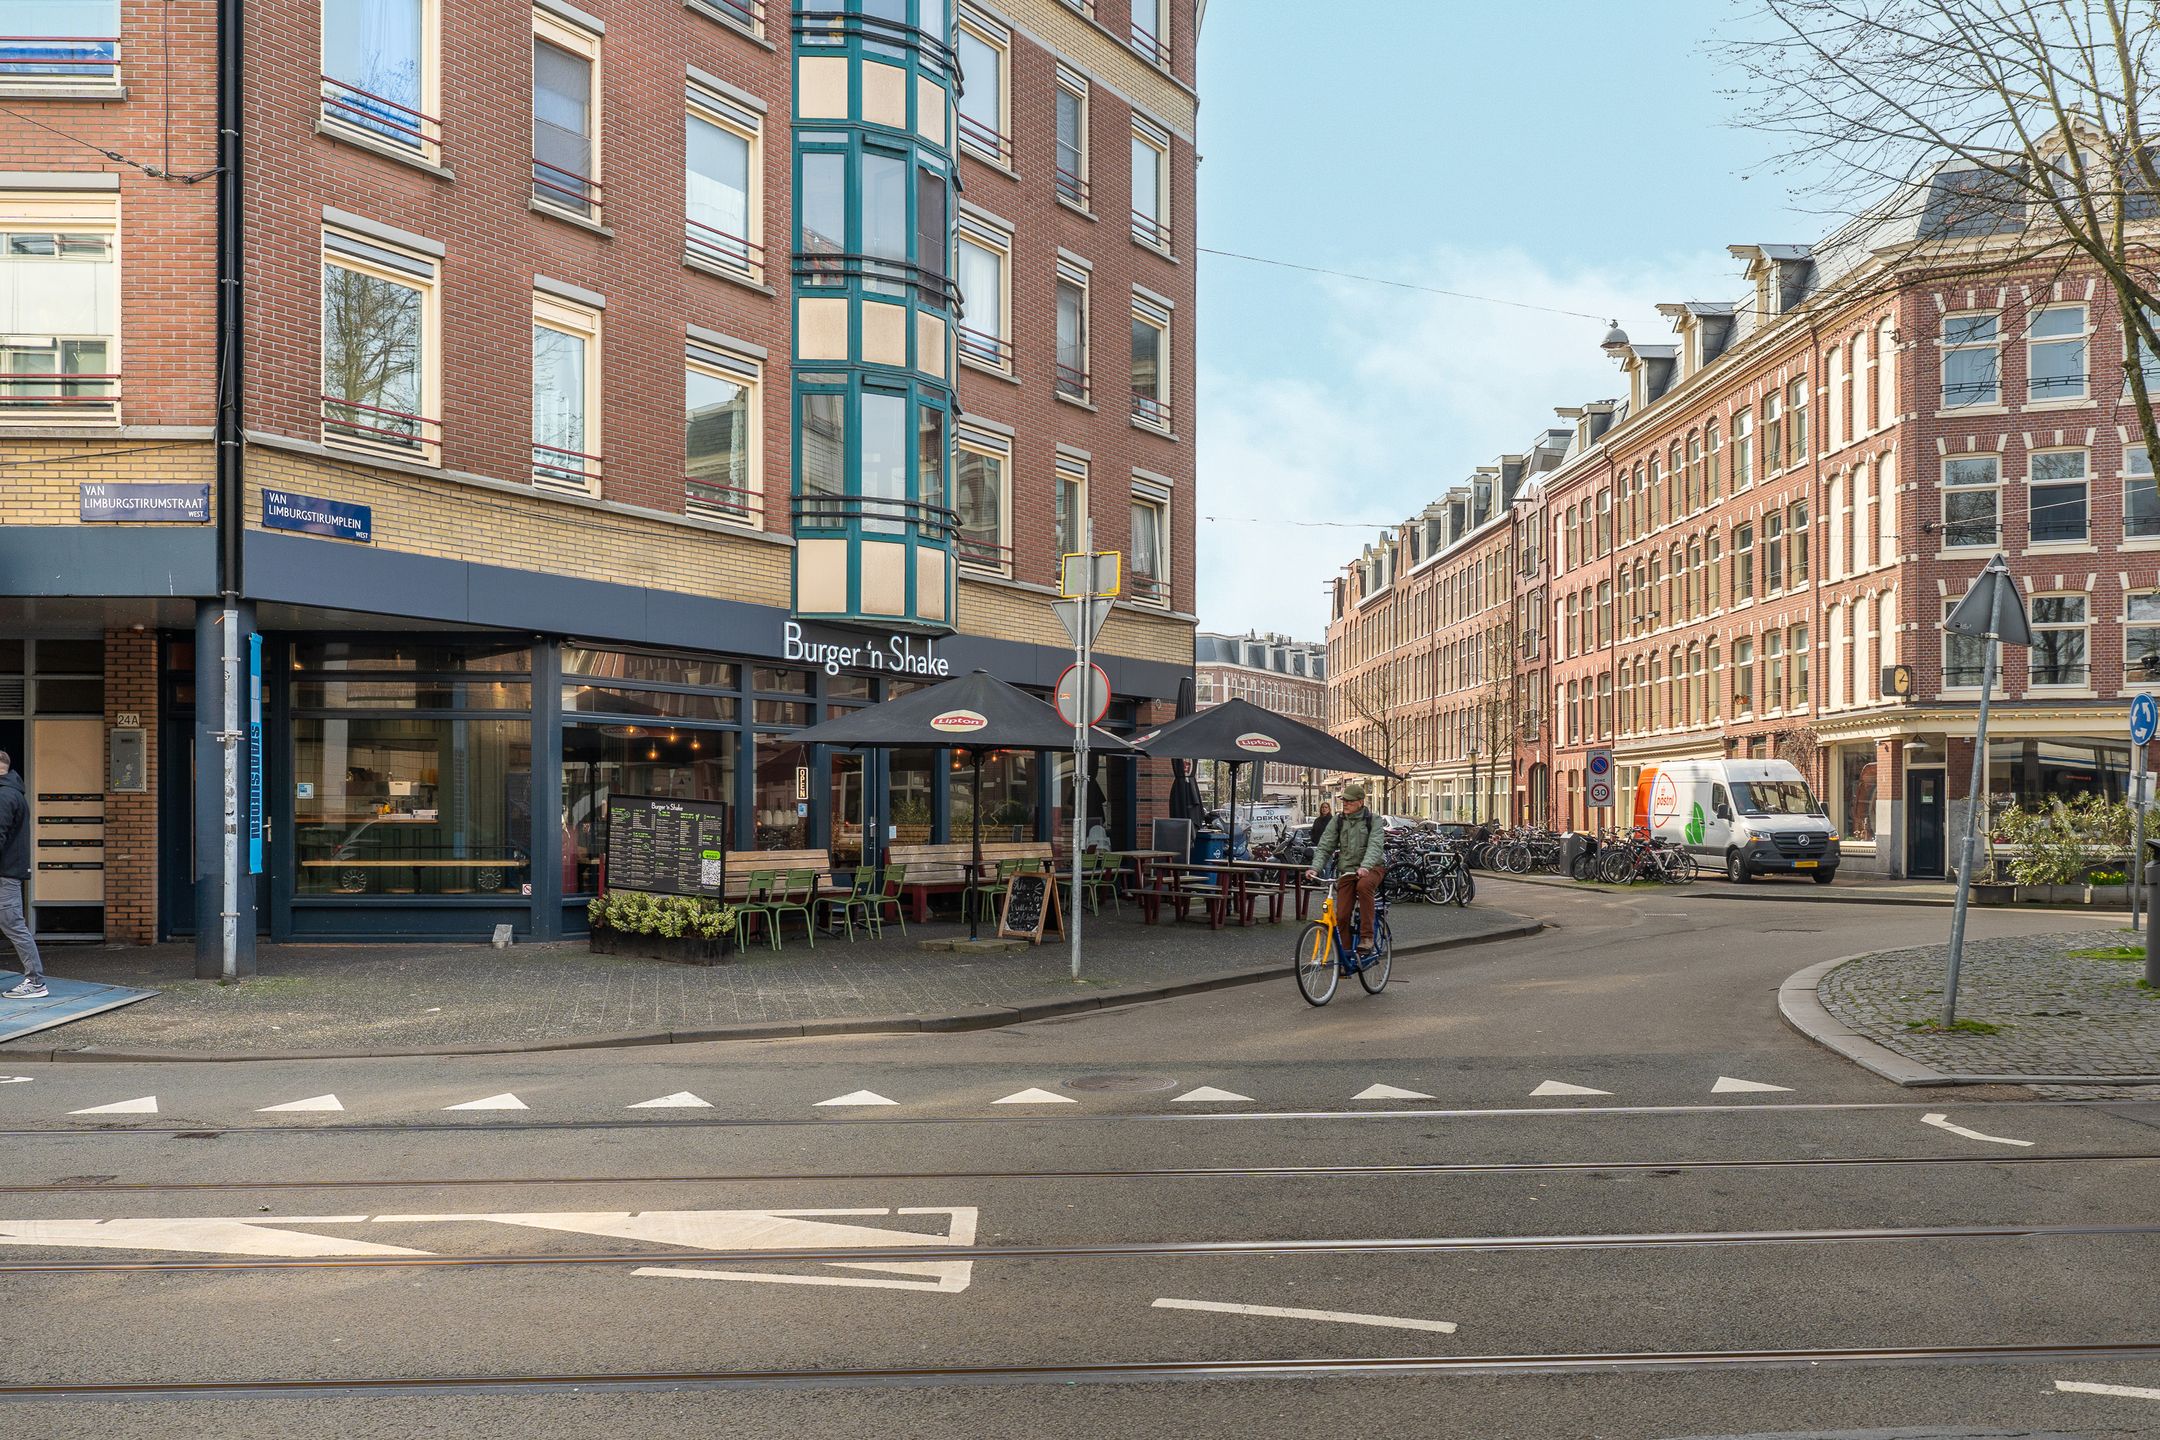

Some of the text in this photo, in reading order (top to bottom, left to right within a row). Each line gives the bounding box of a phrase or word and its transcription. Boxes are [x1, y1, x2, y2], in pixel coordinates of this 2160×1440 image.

[84, 485, 105, 496] VAN
[84, 498, 204, 509] LIMBURGSTIRUMSTRAAT
[269, 492, 287, 505] VAN
[188, 510, 204, 518] WEST
[268, 504, 362, 530] LIMBURGSTIRUMPLEIN
[355, 531, 369, 539] WEST
[783, 621, 861, 676] Burger
[889, 635, 950, 677] Shake
[118, 715, 139, 725] 24A
[938, 717, 979, 725] Lipton
[1241, 738, 1275, 747] Lipton
[1594, 788, 1607, 797] 30
[651, 801, 666, 812] Burger
[670, 803, 684, 812] Shake
